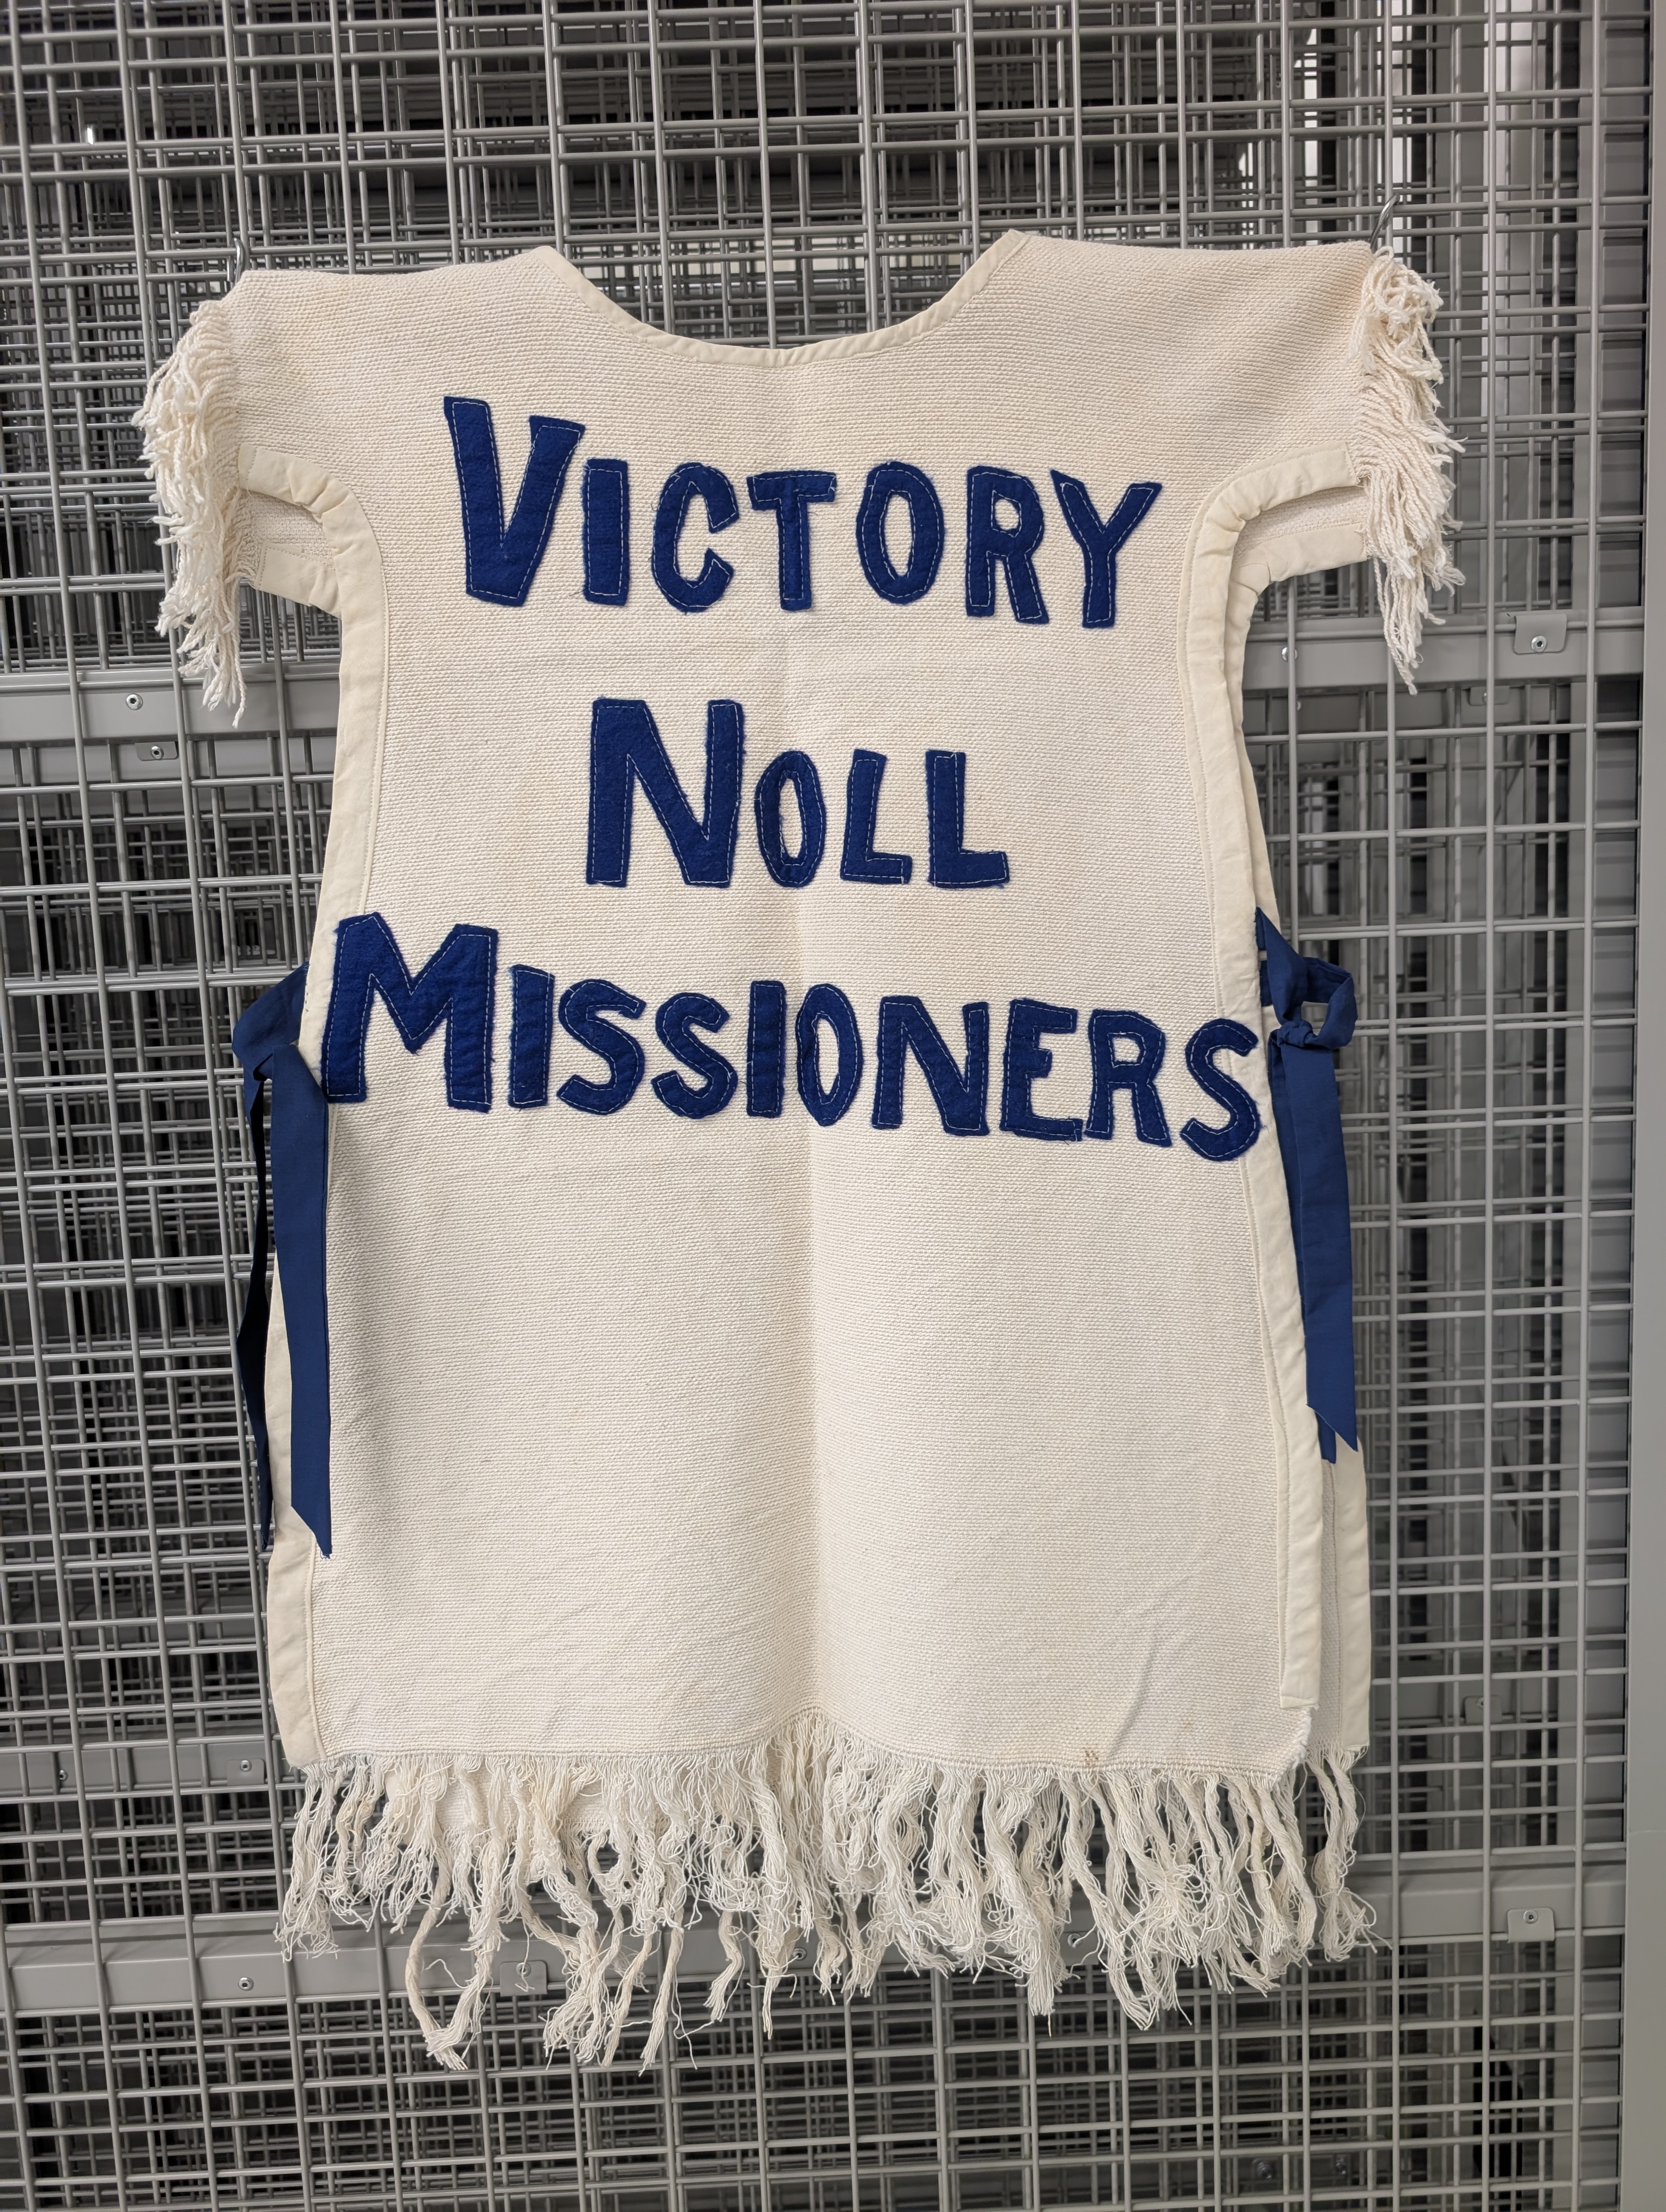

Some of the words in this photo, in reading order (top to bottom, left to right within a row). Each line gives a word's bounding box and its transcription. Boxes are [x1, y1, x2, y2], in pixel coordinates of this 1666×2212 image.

[444, 396, 1162, 628] VICTORY
[586, 698, 1010, 889] NOLL
[322, 912, 1263, 1161] MISSIONERS
